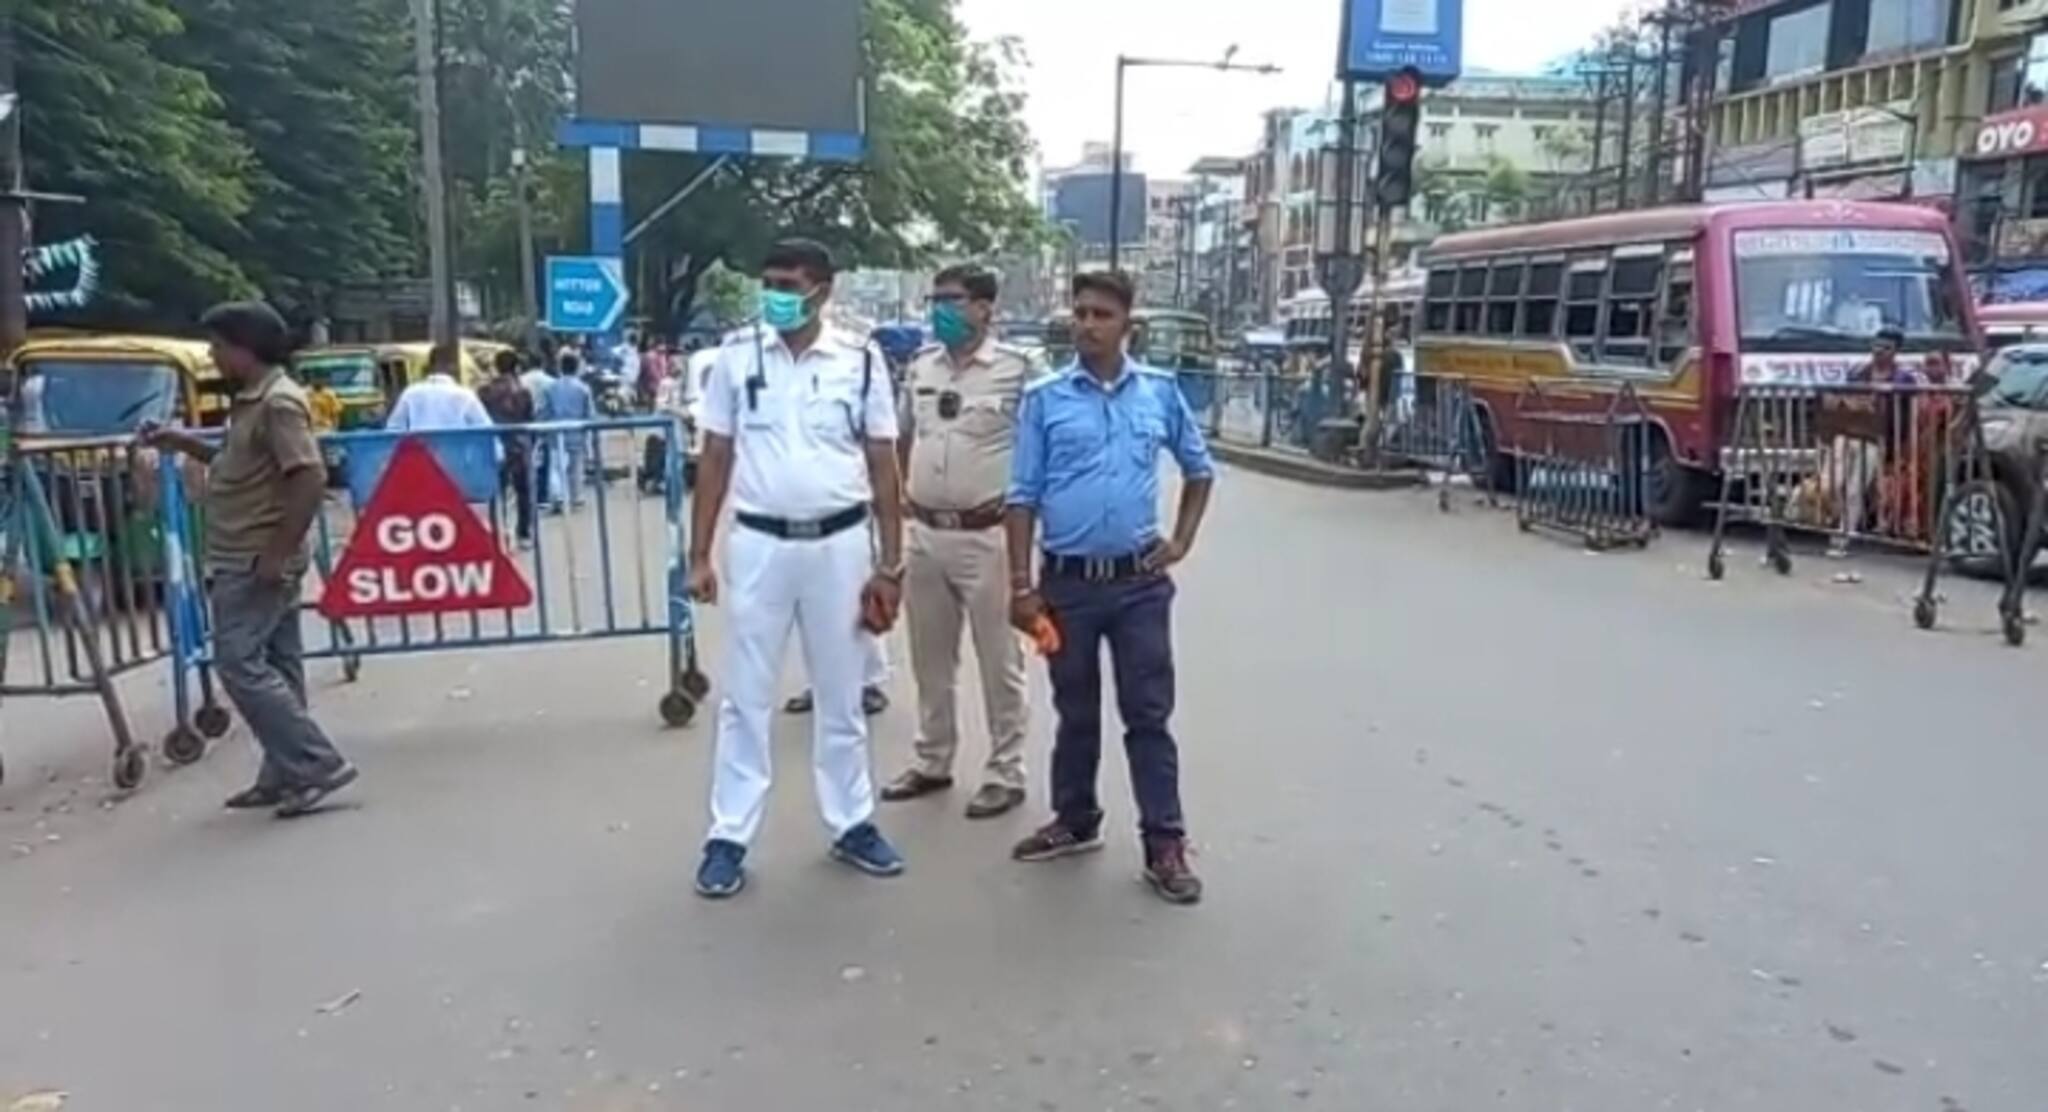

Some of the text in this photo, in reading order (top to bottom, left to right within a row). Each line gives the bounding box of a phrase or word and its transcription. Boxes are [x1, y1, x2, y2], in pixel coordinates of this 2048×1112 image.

[1977, 119, 2034, 152] OYO
[377, 514, 456, 552] GO
[349, 562, 493, 603] SLOW
